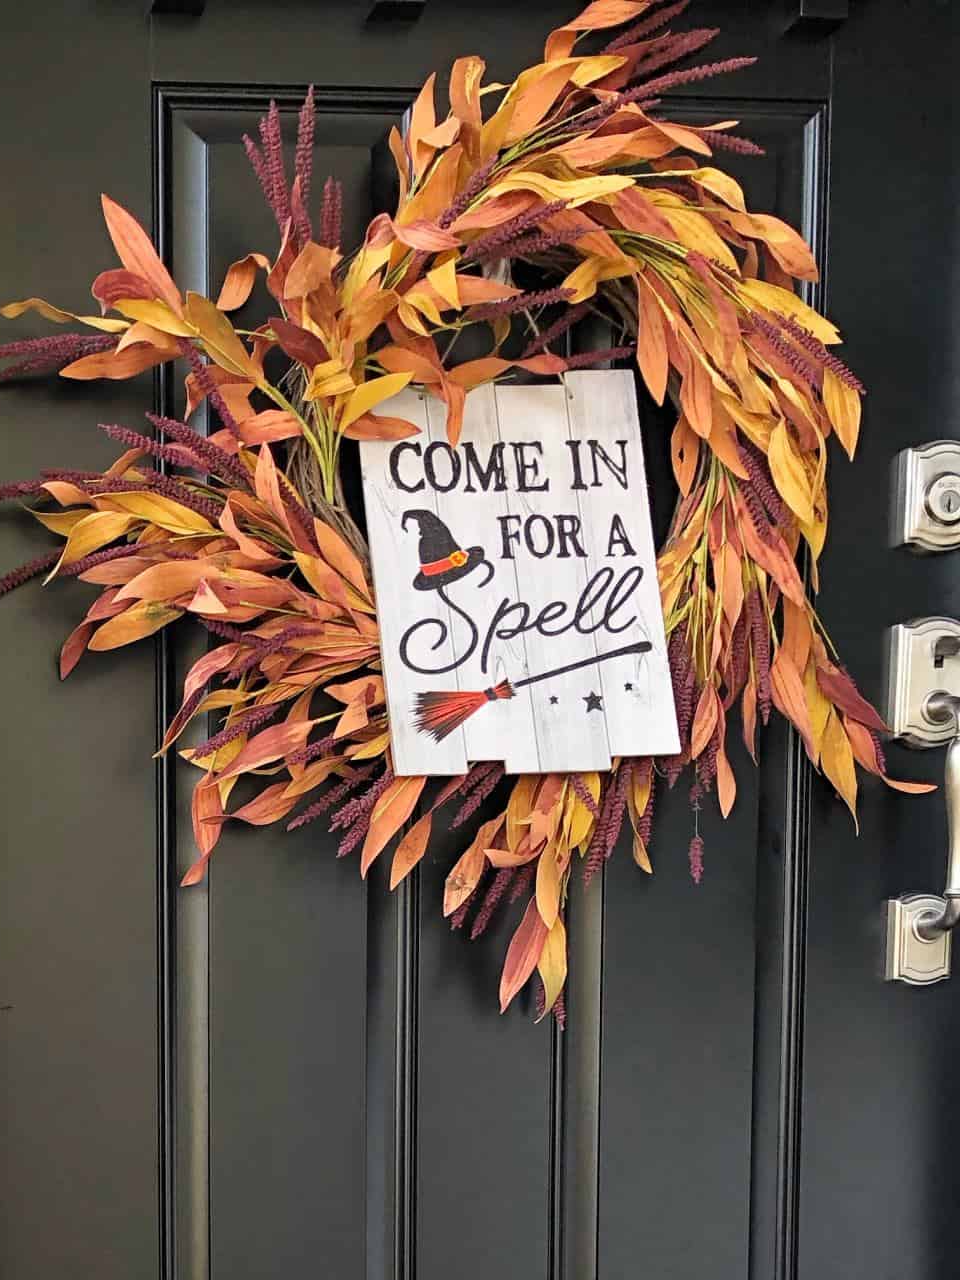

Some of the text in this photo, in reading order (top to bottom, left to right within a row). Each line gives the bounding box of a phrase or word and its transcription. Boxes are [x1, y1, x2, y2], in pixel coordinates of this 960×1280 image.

[389, 439, 629, 493] COME IN
[496, 514, 638, 559] FOR A
[398, 560, 644, 675] Spell
